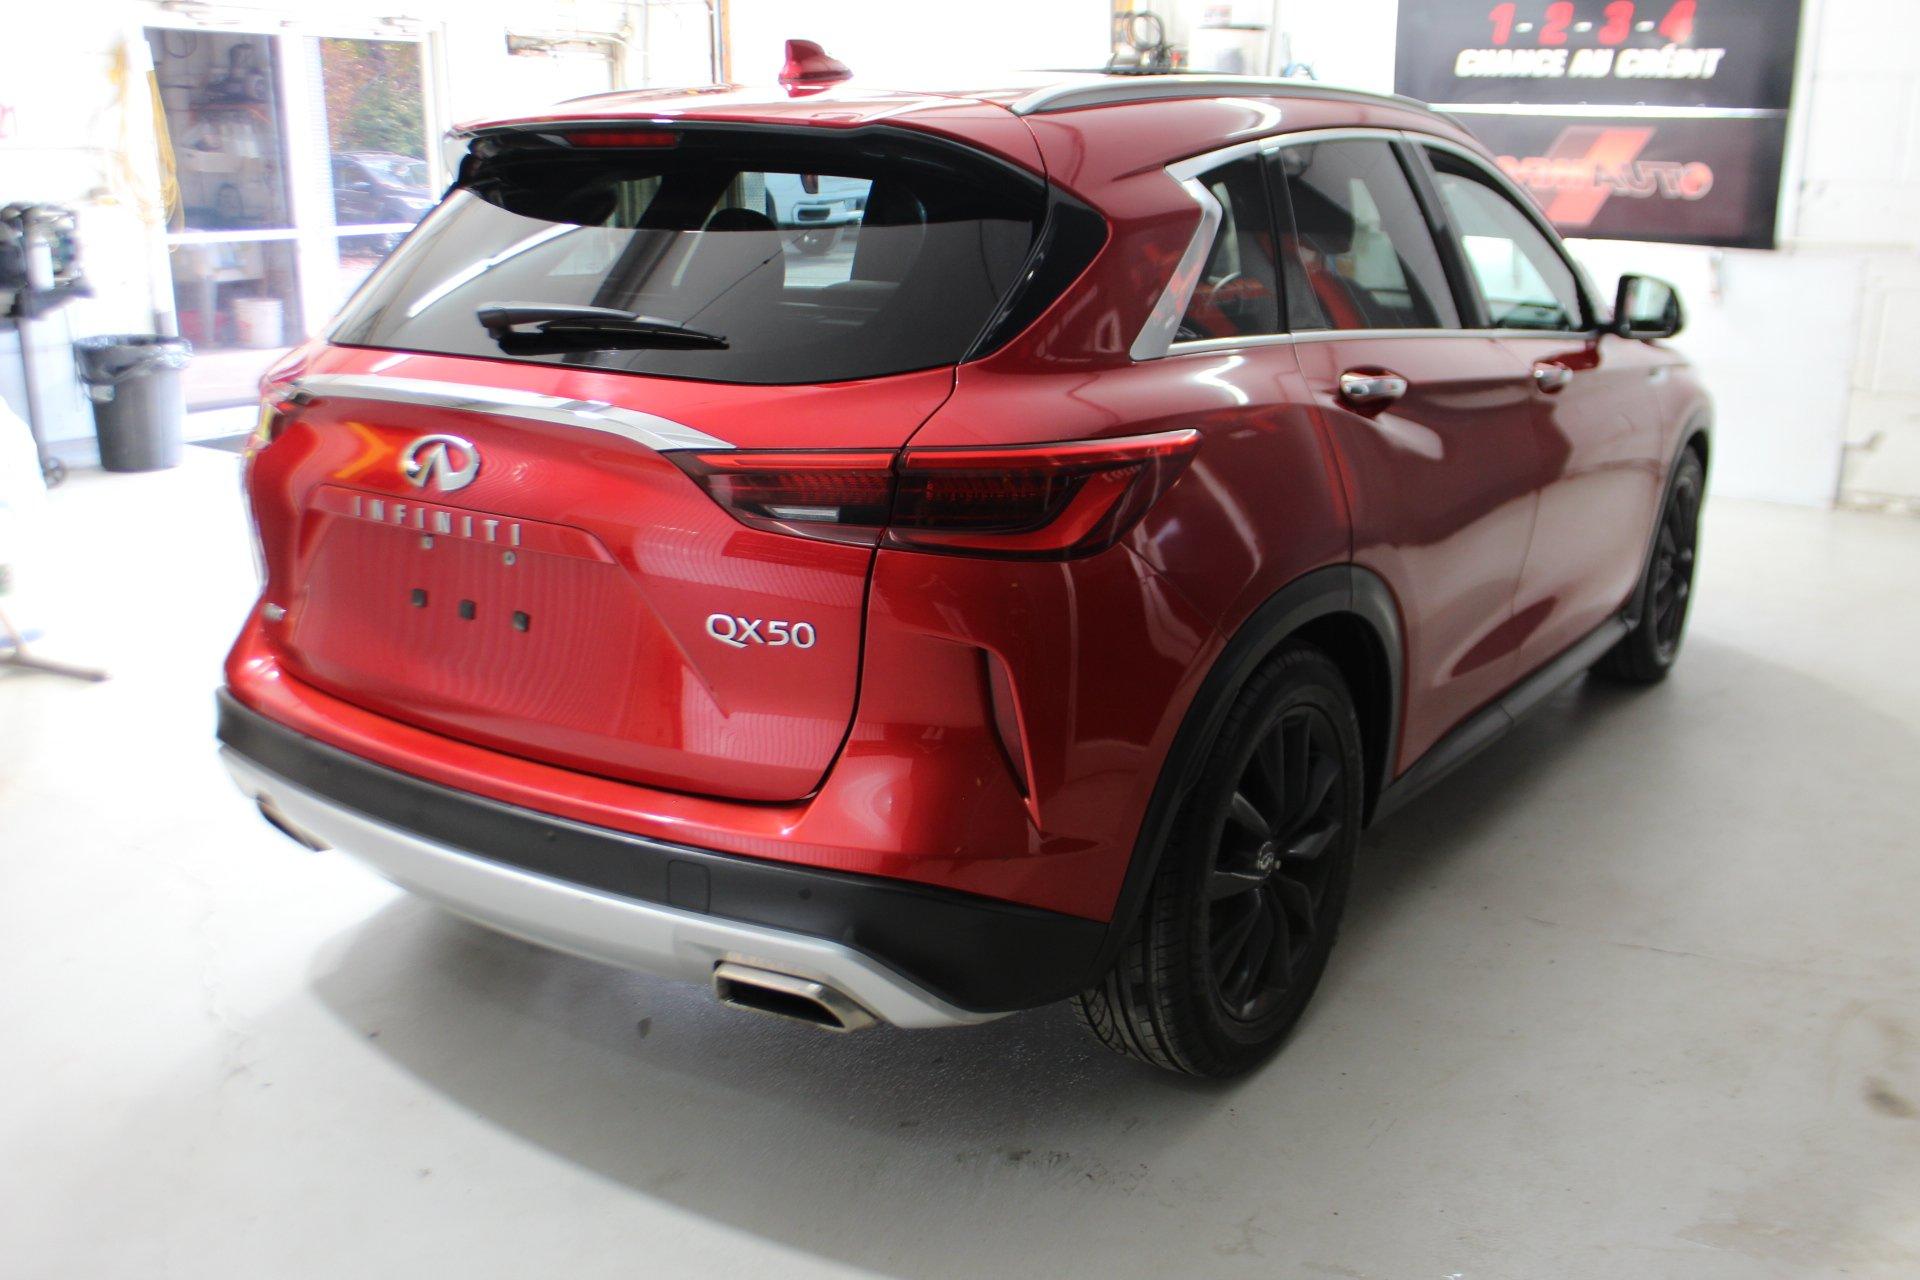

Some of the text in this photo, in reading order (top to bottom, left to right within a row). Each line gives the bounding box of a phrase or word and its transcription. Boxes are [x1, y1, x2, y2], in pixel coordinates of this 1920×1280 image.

[1488, 0, 1697, 45] 1-2-3-4
[1454, 48, 1568, 77] CHANCE
[1614, 43, 1726, 79] CRÉDIT
[354, 495, 520, 546] INFINITI
[705, 613, 816, 649] QX50
